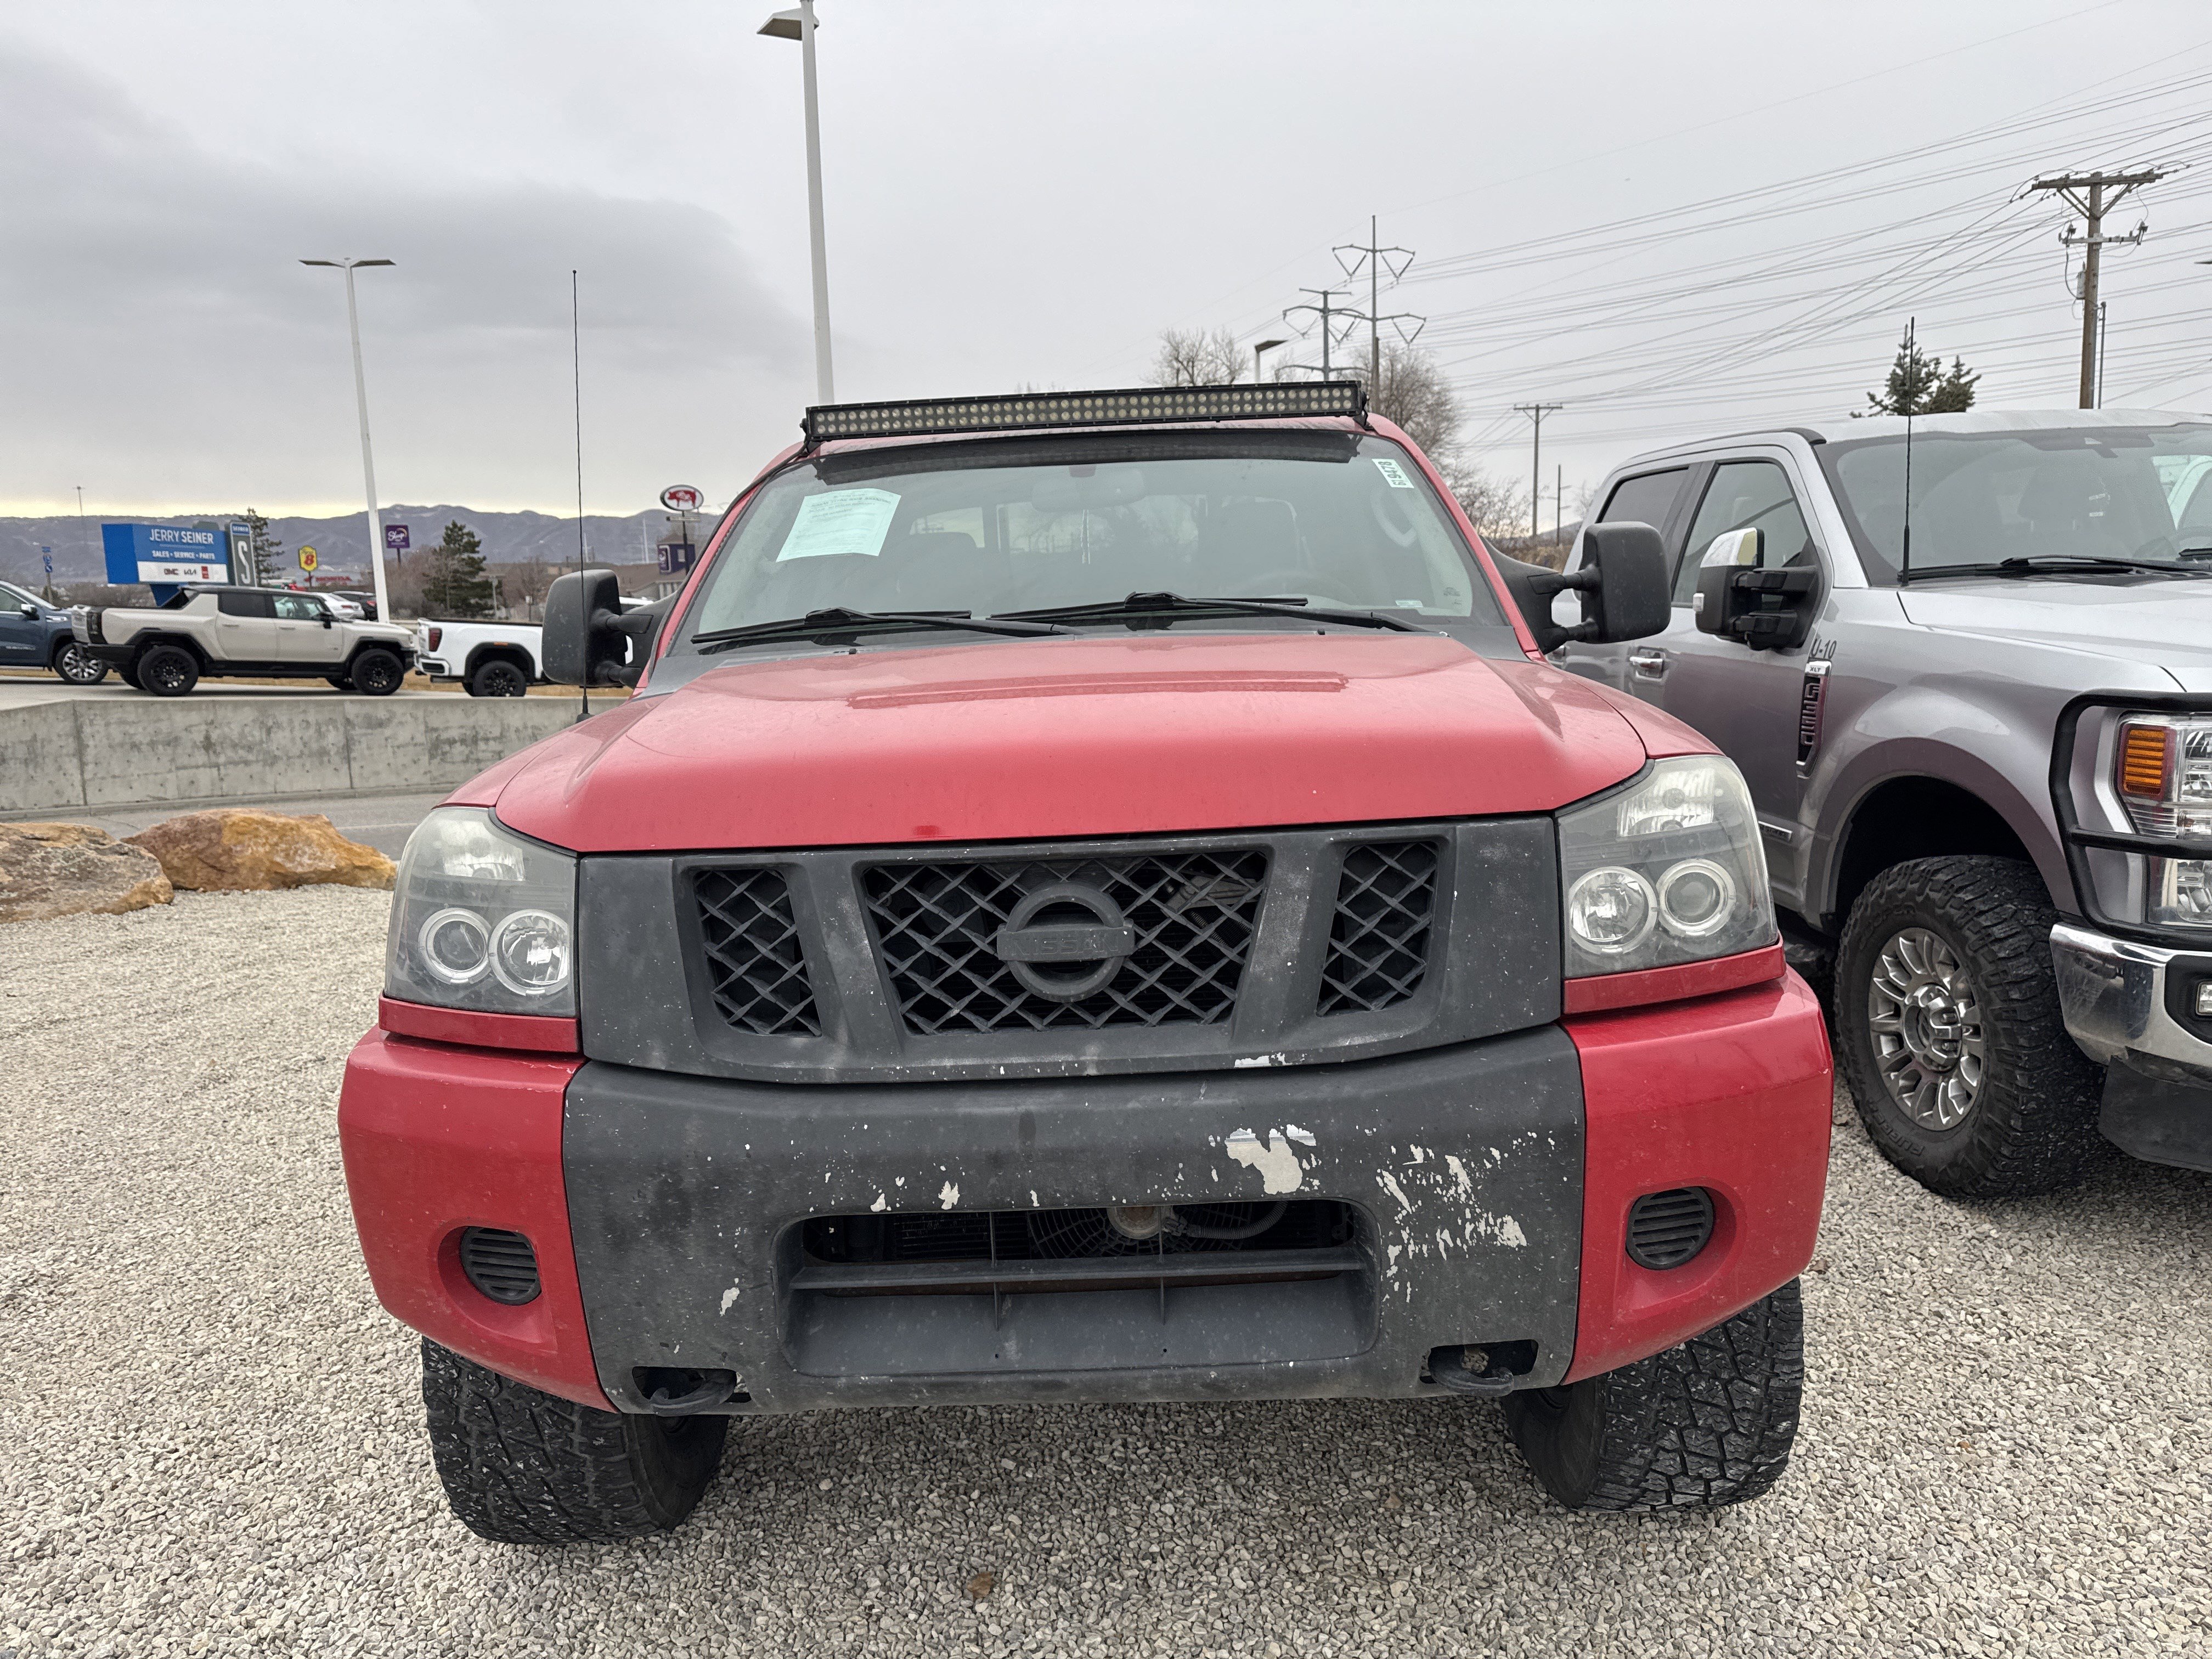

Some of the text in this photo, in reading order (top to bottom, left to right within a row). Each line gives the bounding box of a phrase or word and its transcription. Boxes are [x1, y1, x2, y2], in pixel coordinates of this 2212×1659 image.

[150, 529, 213, 544] JERRY SEINER
[305, 555, 314, 565] 8
[1010, 933, 1119, 955] NISSAN
